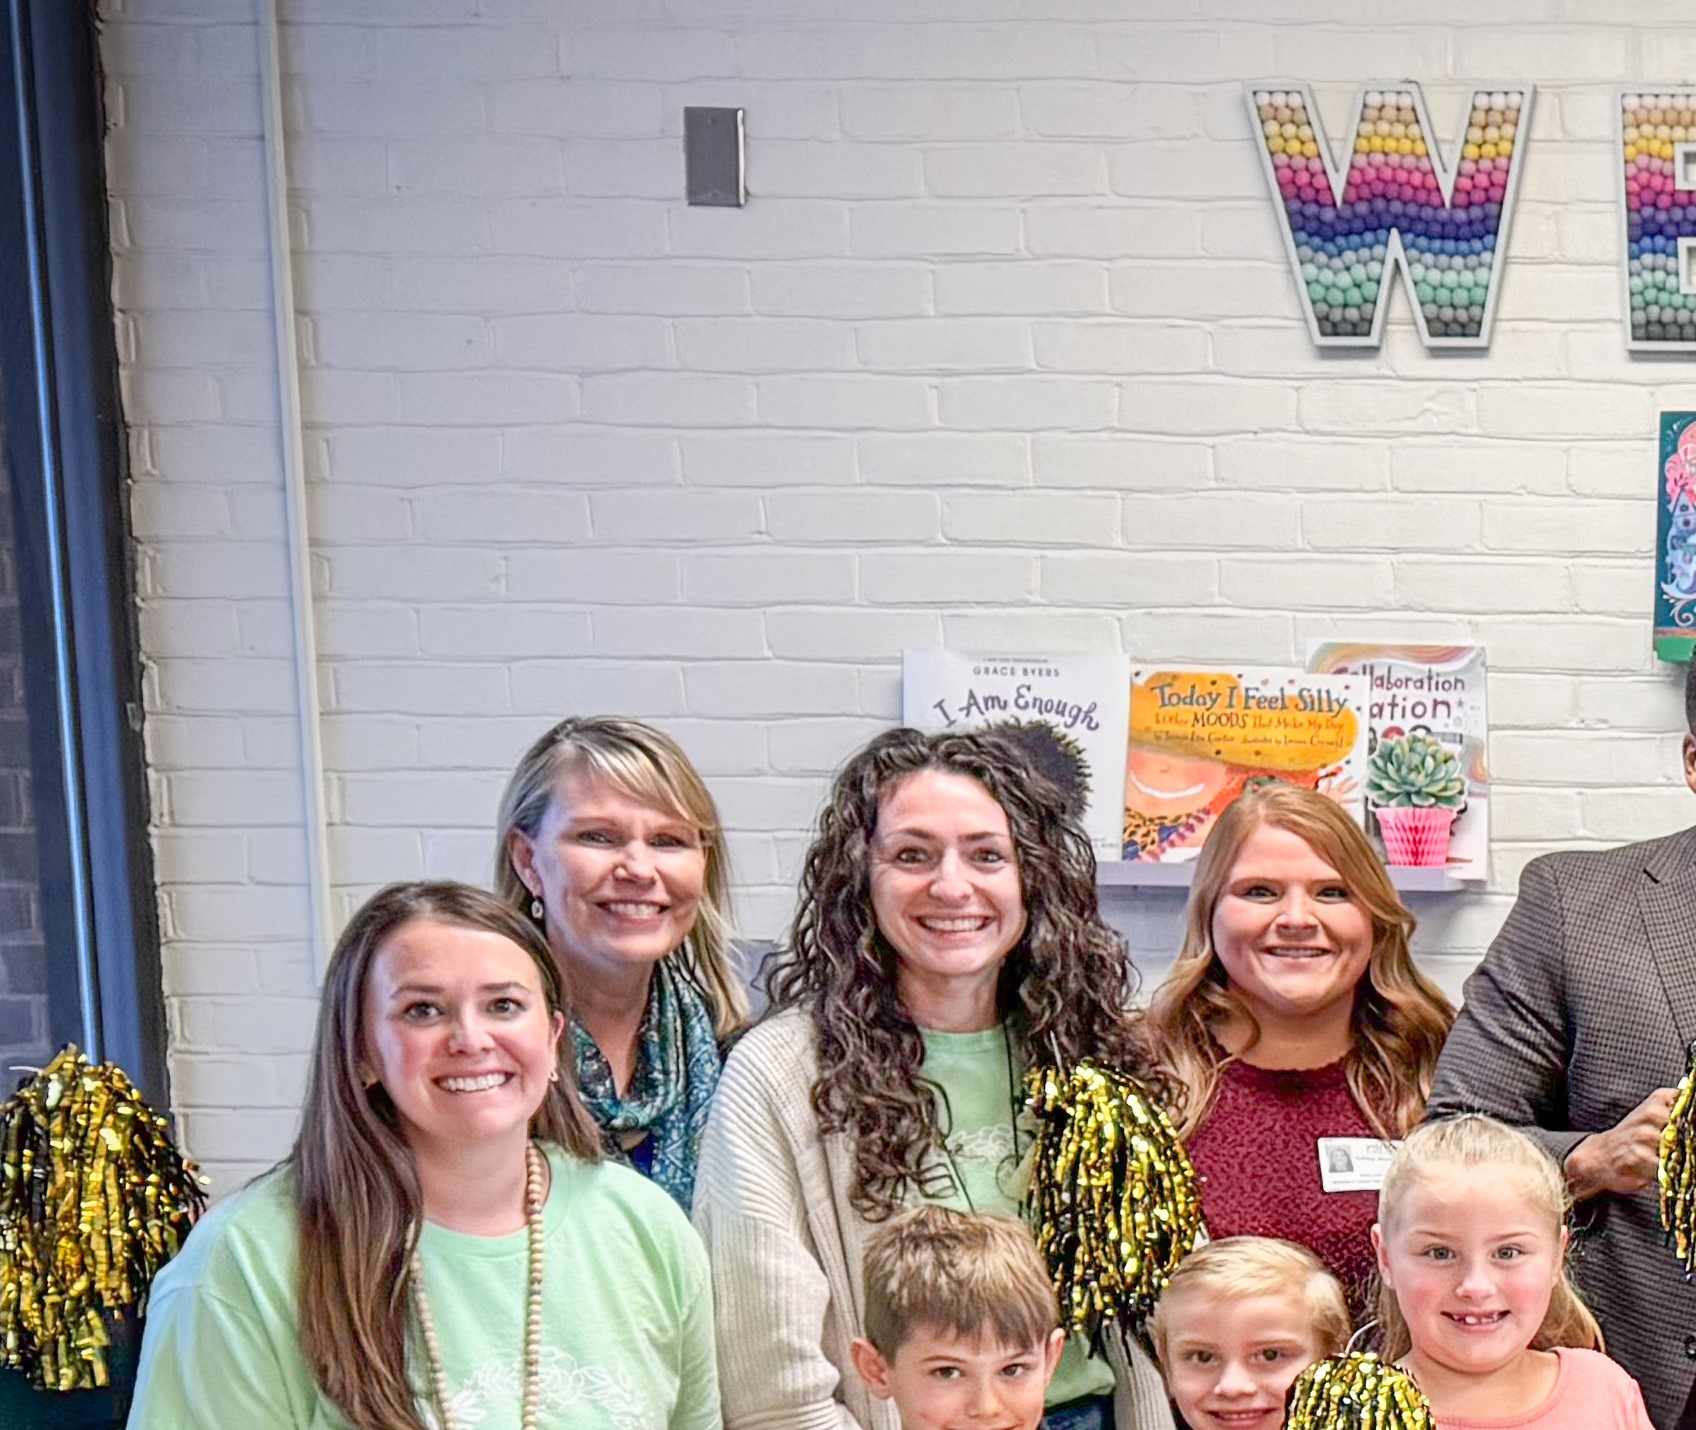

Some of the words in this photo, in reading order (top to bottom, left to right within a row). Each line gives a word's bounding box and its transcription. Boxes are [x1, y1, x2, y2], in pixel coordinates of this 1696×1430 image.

[973, 666, 1016, 677] GRACE
[1022, 667, 1060, 678] BYERS
[933, 699, 957, 729] I
[958, 688, 1008, 718] Am
[1014, 684, 1100, 732] Enough
[1151, 682, 1223, 711] Today
[1224, 686, 1238, 708] I
[1243, 686, 1288, 710] Feel
[1294, 687, 1348, 717] Silly
[1191, 712, 1250, 728] MOODS
